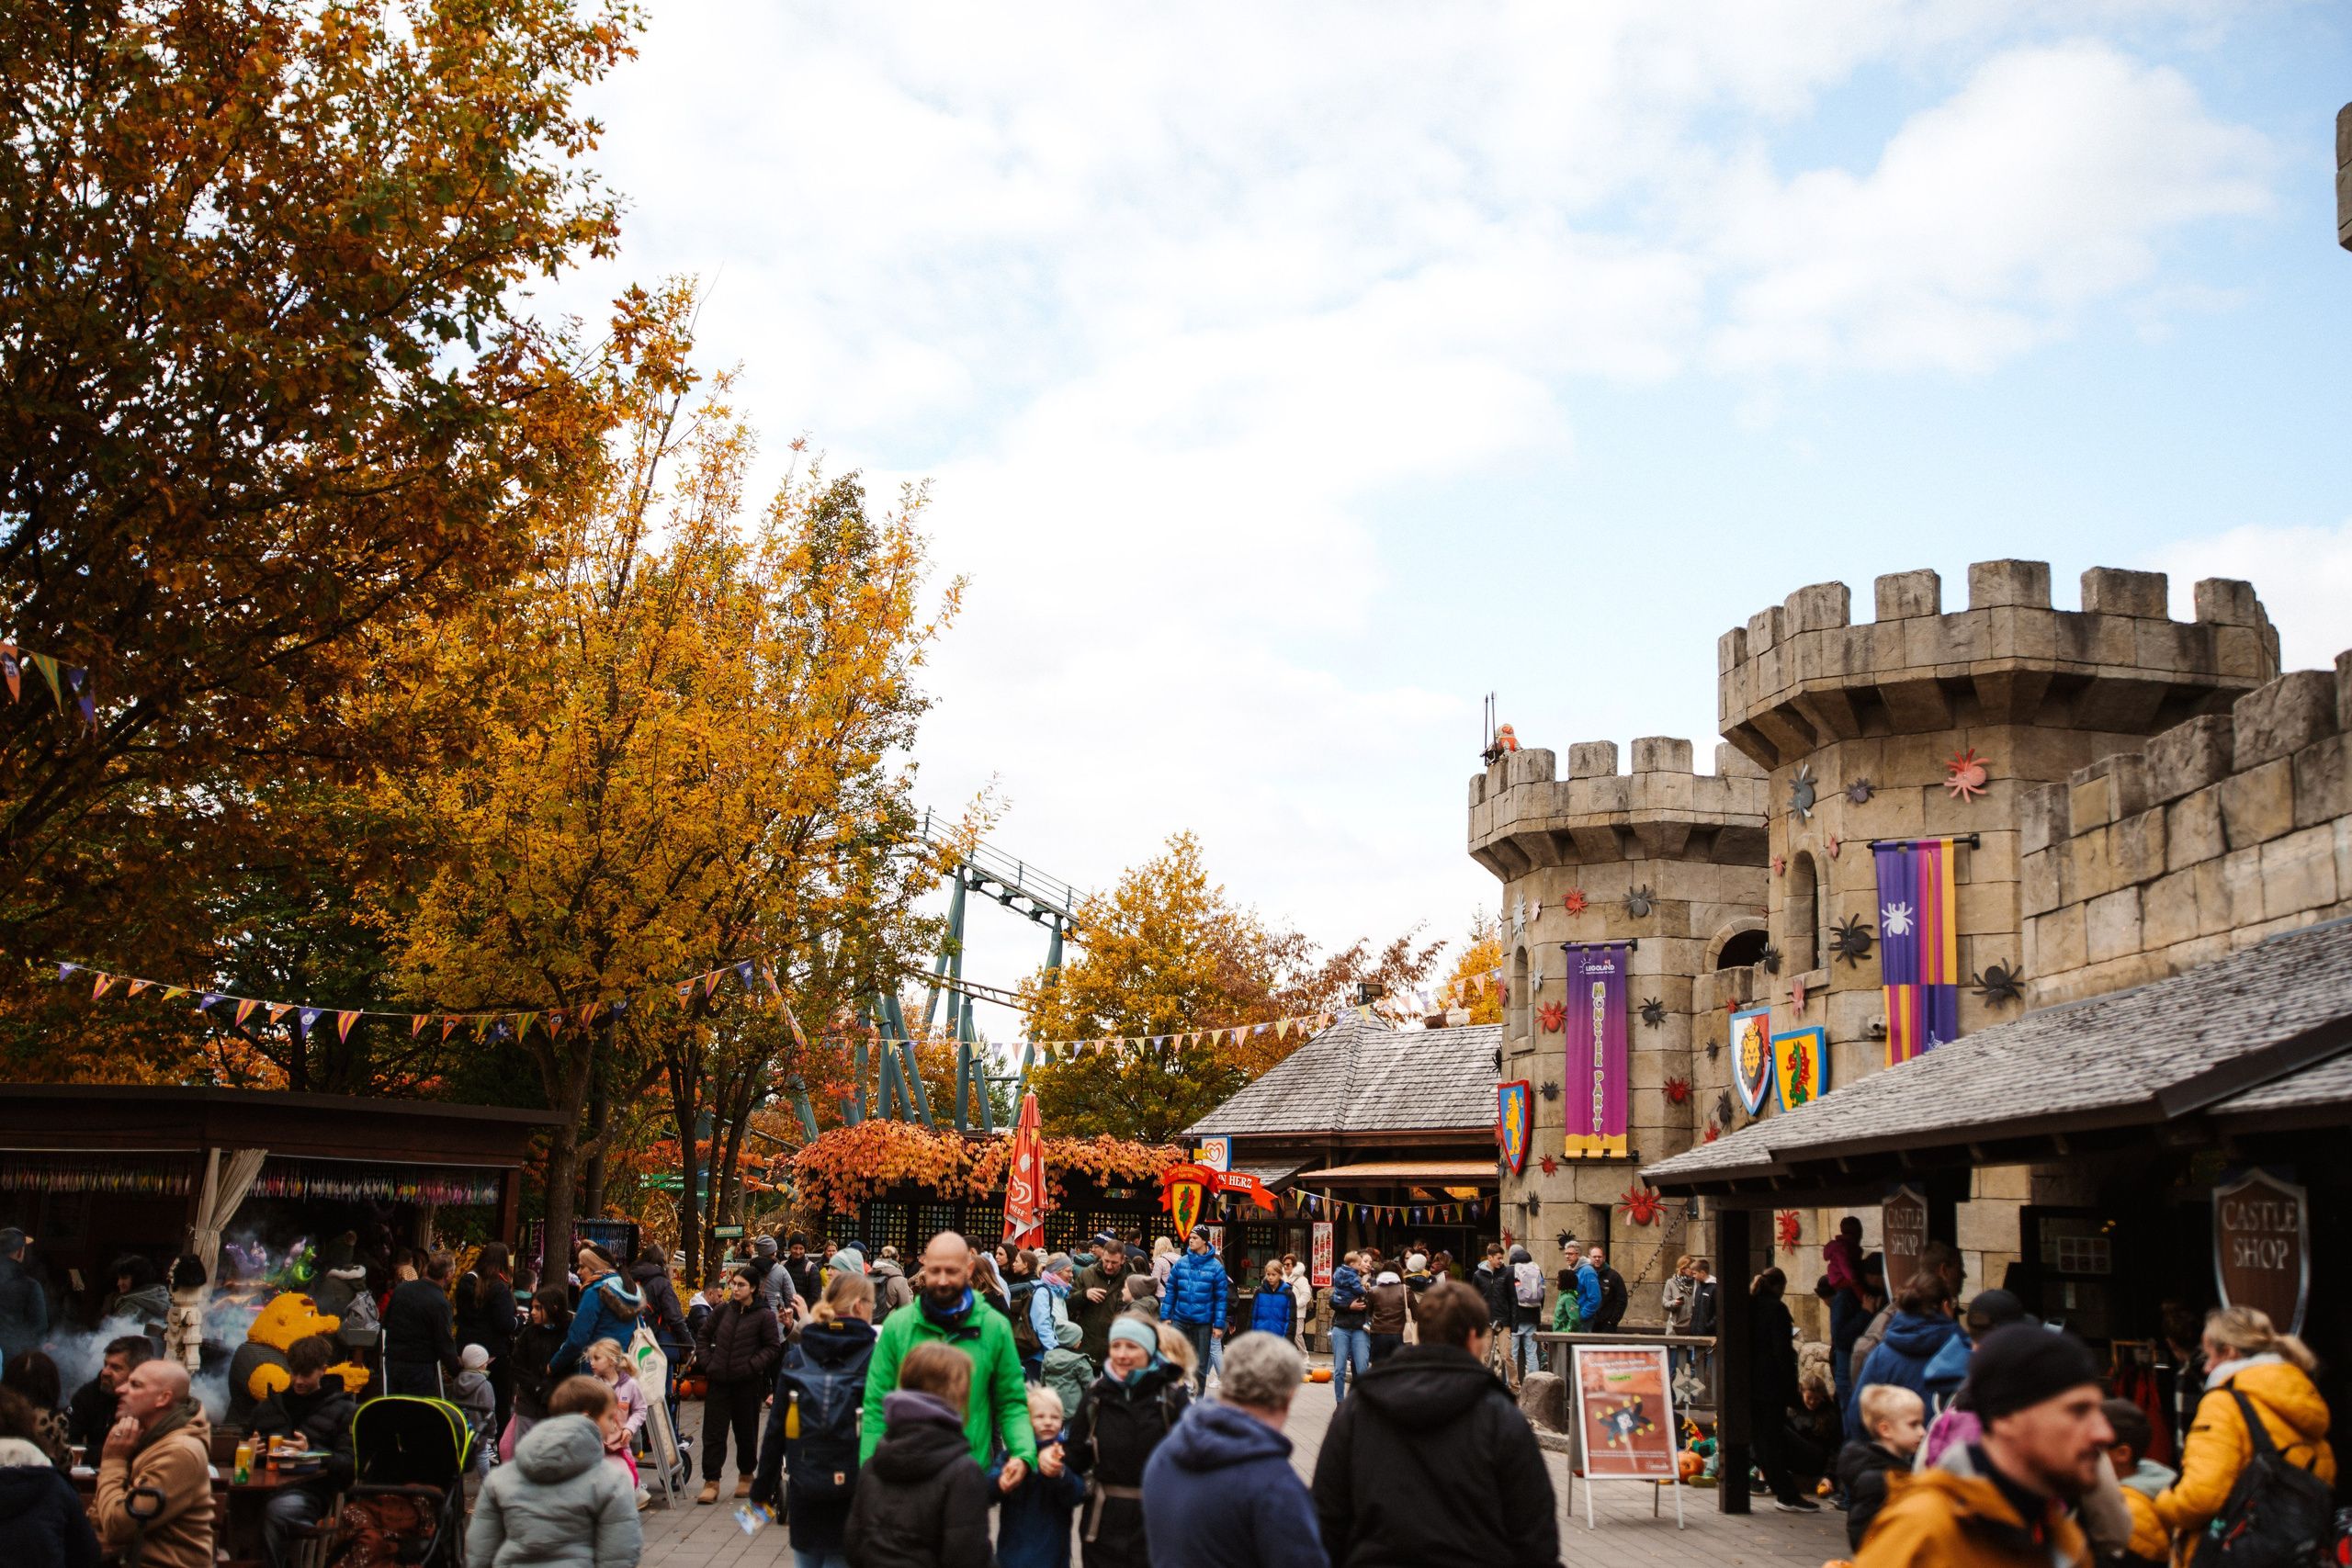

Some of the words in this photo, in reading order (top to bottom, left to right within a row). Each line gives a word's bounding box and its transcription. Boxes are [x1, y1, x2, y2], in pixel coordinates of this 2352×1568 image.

[1586, 960, 1614, 971] LEGOLAND
[1592, 981, 1605, 1067] MONSTER
[1592, 1070, 1604, 1132] PARTY
[1228, 1175, 1253, 1190] HERZ
[1010, 1202, 1025, 1217] NESE
[1887, 1209, 1923, 1229] CASTLE
[2222, 1201, 2298, 1232] CASTLE
[1892, 1235, 1918, 1256] SHOP
[2233, 1238, 2289, 1269] SHOP
